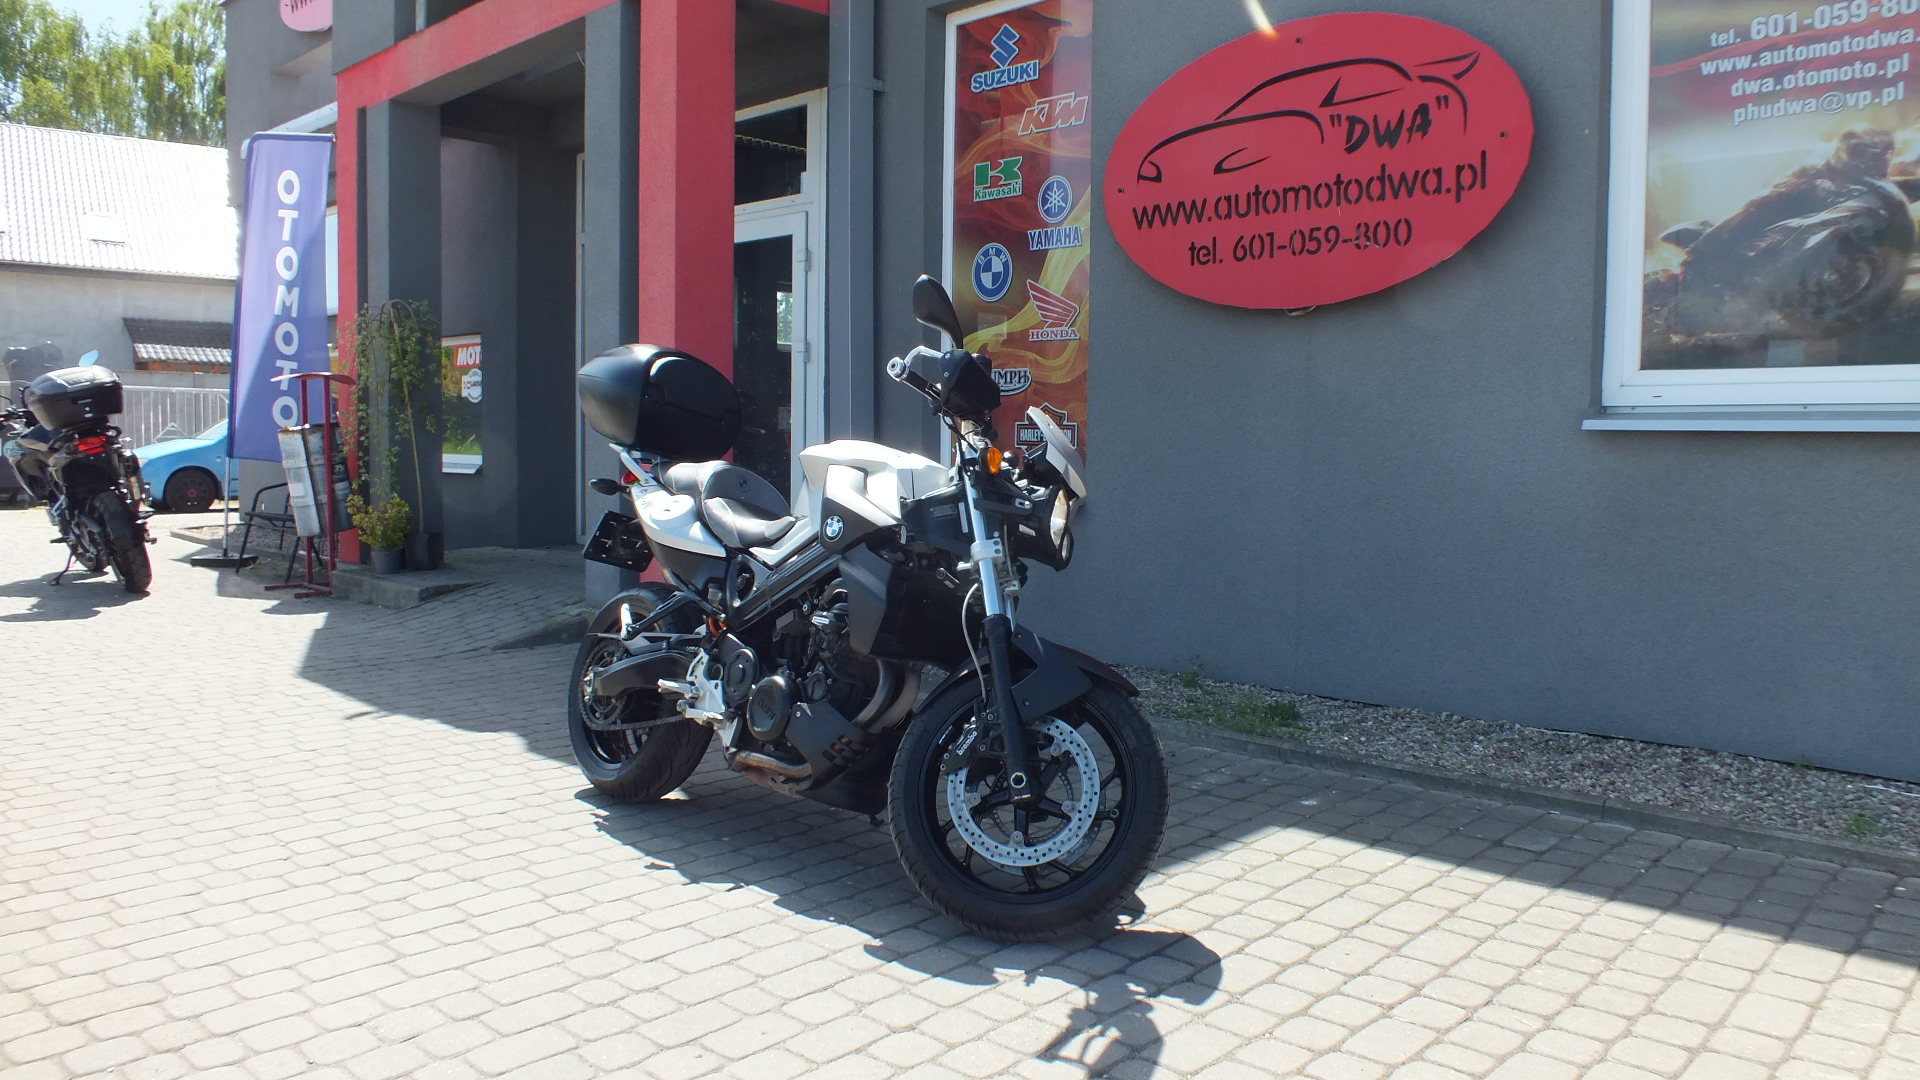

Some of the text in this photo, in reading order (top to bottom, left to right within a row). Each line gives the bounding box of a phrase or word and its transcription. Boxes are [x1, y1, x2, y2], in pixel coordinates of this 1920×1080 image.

[1710, 0, 1920, 48] tel. 601-059-80
[971, 60, 1039, 92] SUZUKI
[1731, 53, 1910, 97] dwa.otomoto.pl
[1018, 92, 1088, 136] KTM
[1733, 81, 1905, 126] phudwa@vp.pl
[974, 181, 1022, 201] Kawasaki
[1132, 150, 1487, 230] www.automotodwa.pl
[977, 247, 1008, 265] BMW
[1028, 225, 1082, 250] YAMAHA
[1188, 217, 1413, 267] tel. 601-059-800
[272, 169, 300, 429] OTOMOTO
[1029, 328, 1080, 341] HONDA
[457, 345, 482, 366] MOT
[956, 730, 978, 756] brembo
